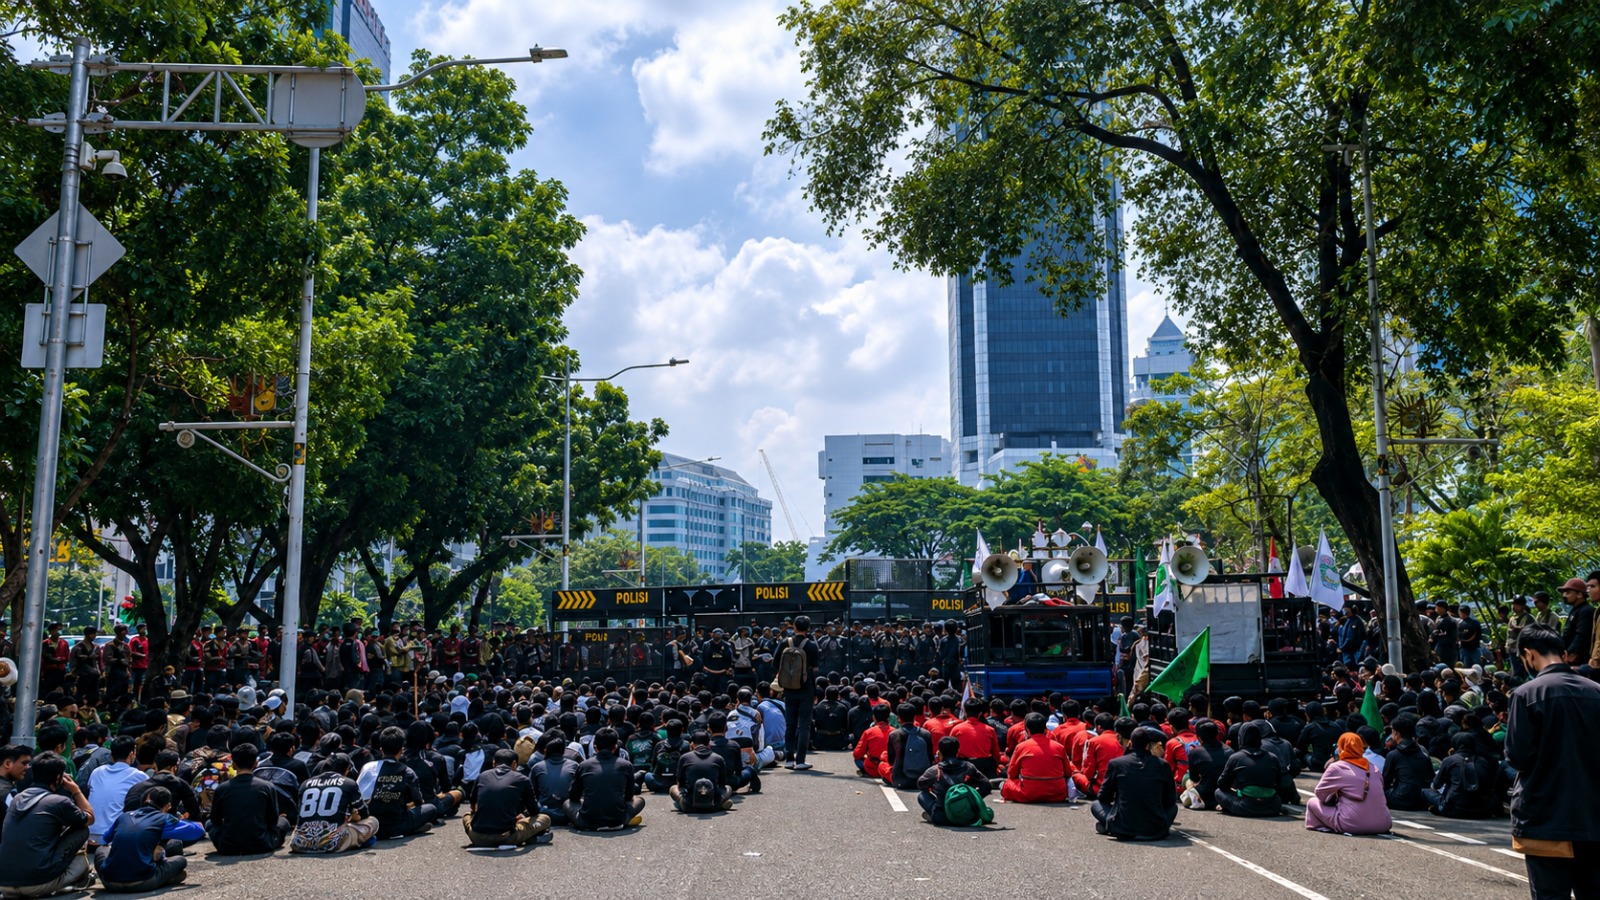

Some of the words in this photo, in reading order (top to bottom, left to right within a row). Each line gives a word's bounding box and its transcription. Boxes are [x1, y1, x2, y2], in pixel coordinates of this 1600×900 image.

[616, 591, 649, 604] POLISI
[756, 586, 789, 599] POLISI
[932, 599, 964, 610] POLISI
[300, 787, 342, 818] 80
